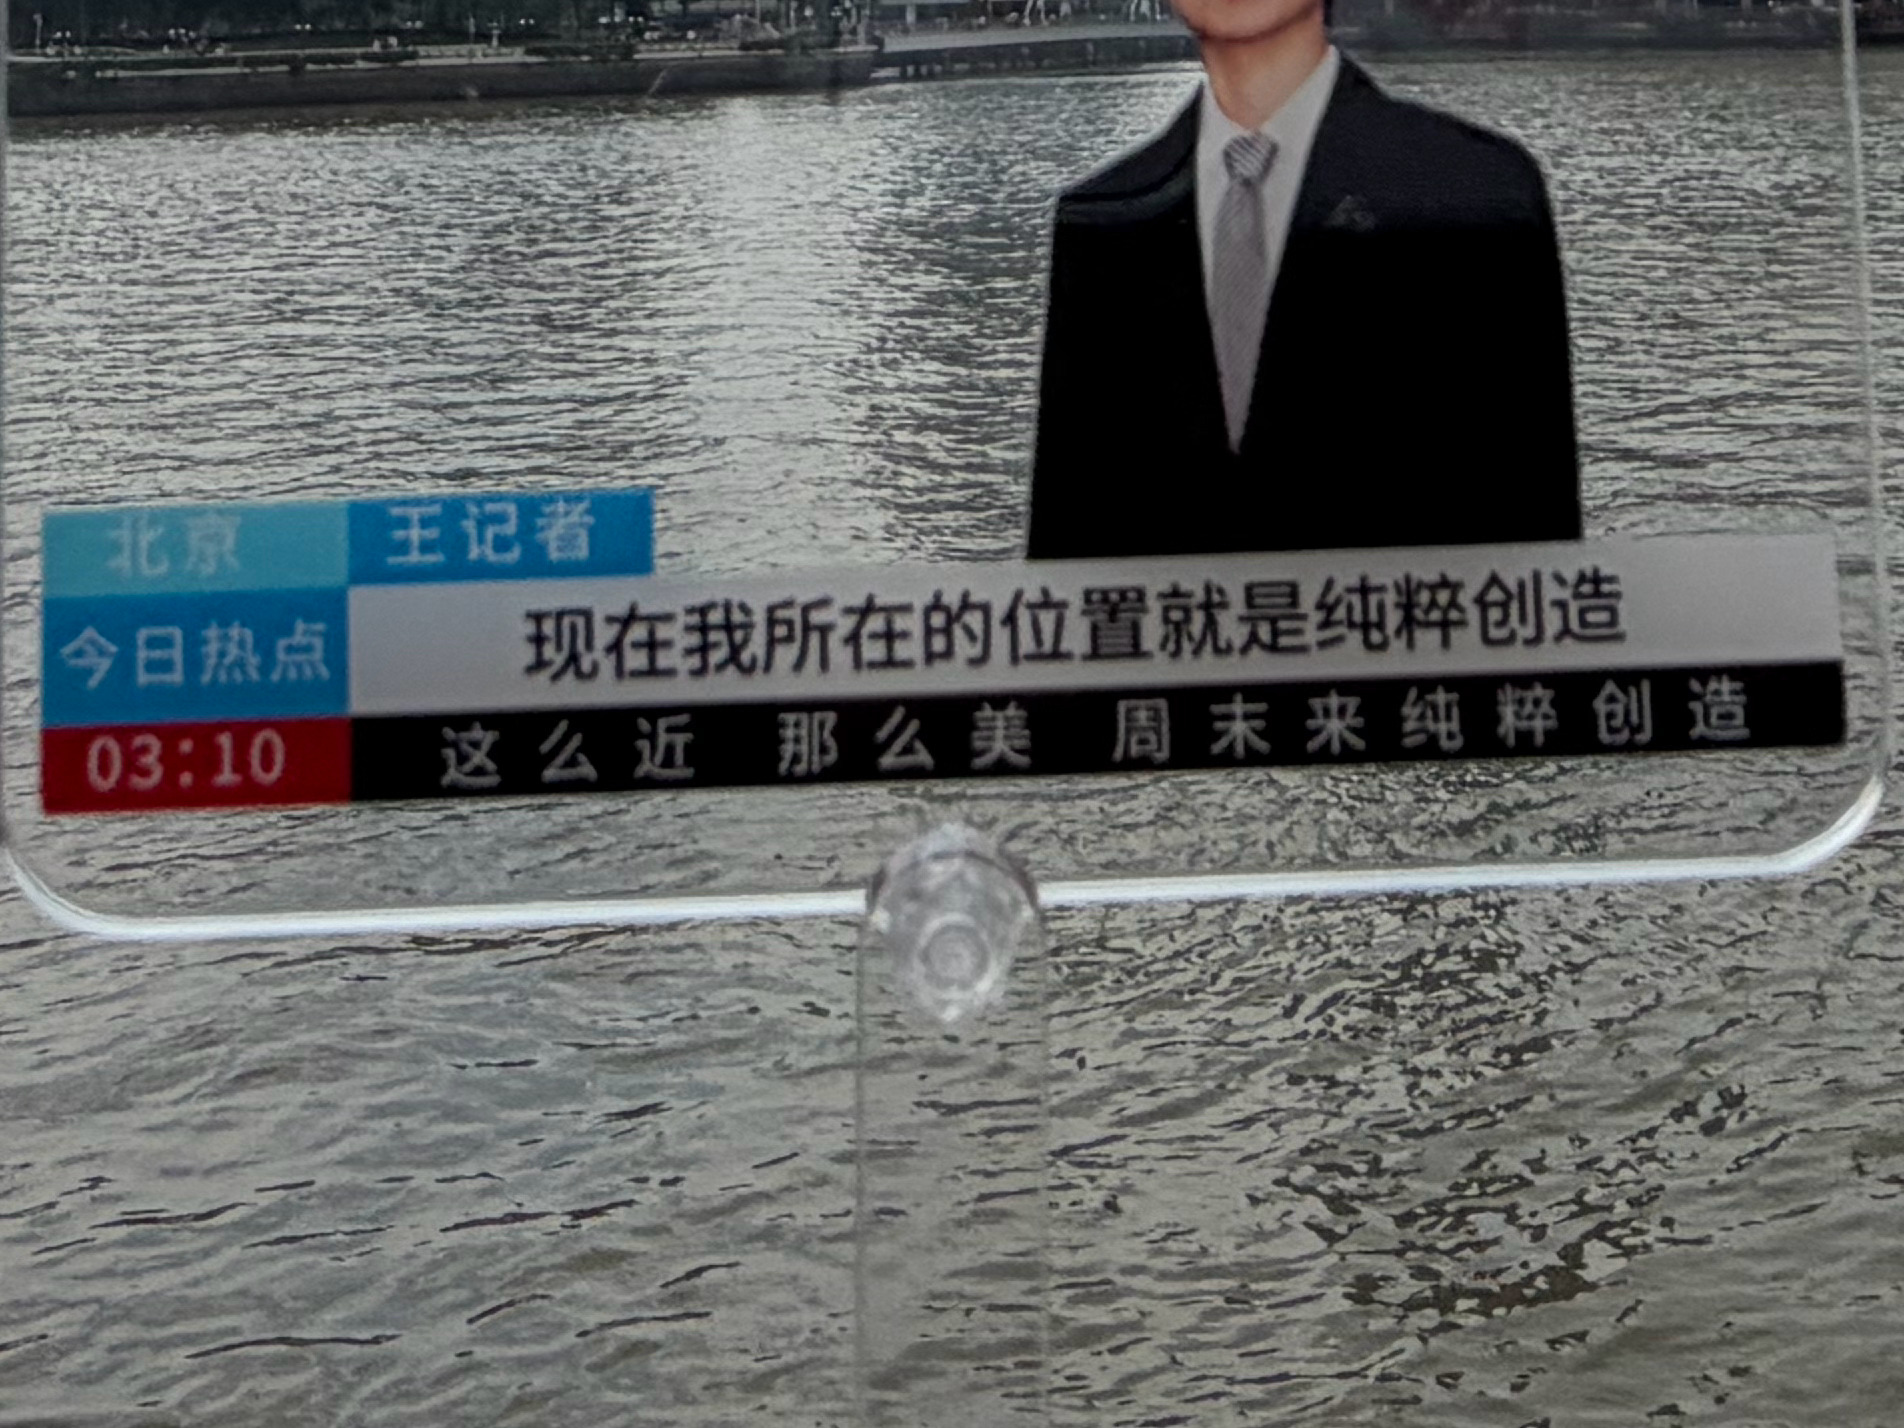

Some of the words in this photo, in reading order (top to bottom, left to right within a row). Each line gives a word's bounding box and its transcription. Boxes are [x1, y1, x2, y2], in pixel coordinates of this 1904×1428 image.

[107, 511, 243, 579] 北京
[384, 499, 597, 566] 王记者
[59, 621, 332, 689] 今日热点
[524, 568, 1627, 683] 现在我所在的位置就是纯粹创造
[86, 729, 287, 793] 03:10
[440, 714, 696, 789] 这么近
[776, 699, 1033, 780] 那么美
